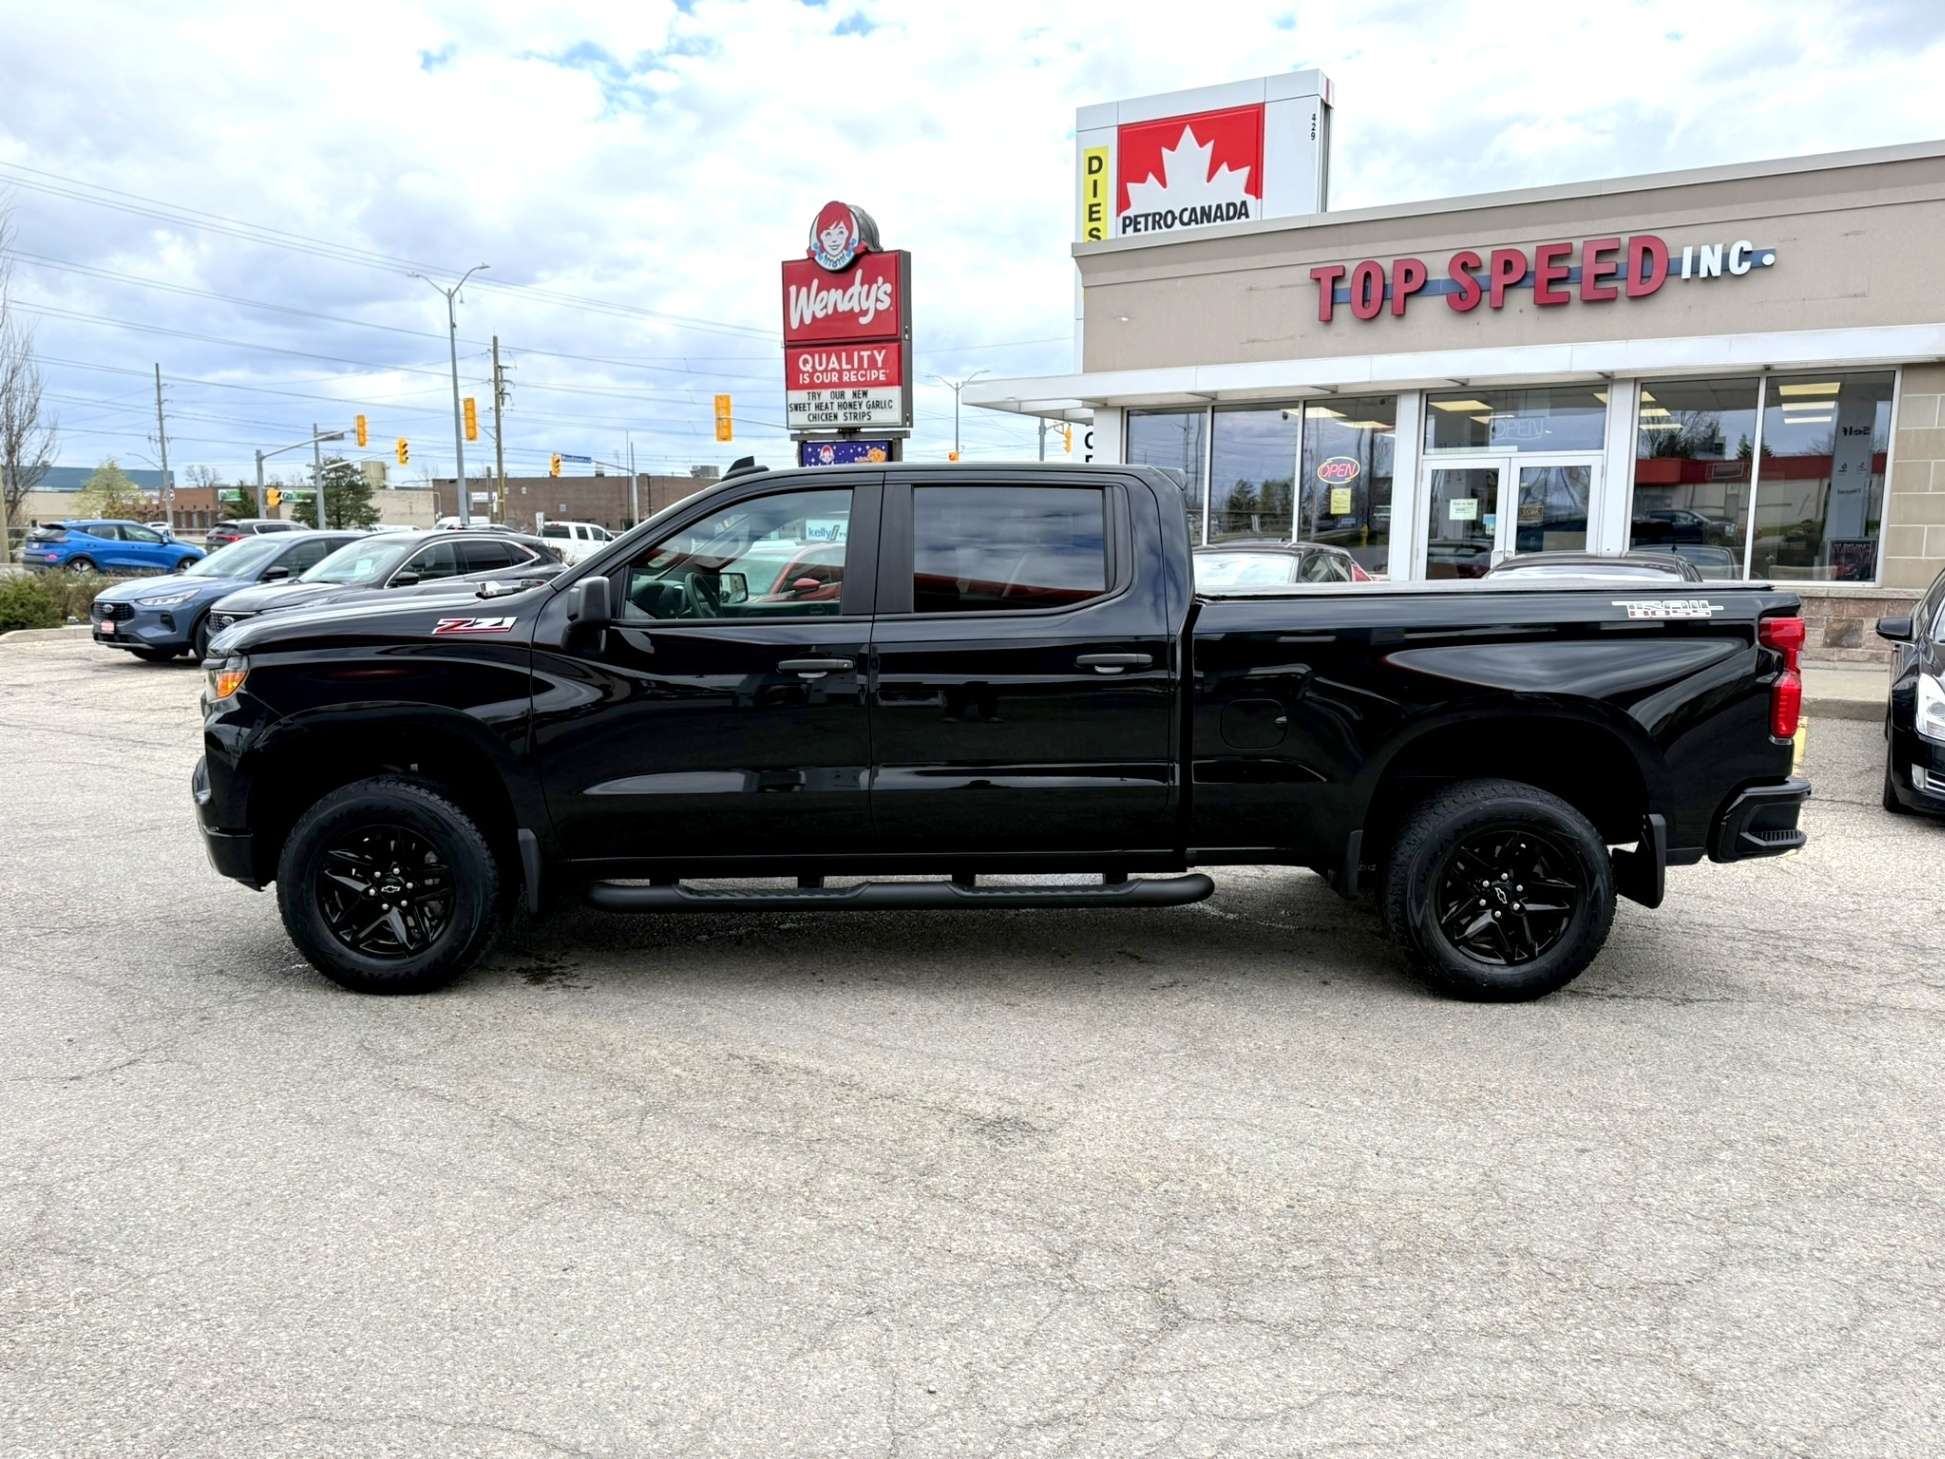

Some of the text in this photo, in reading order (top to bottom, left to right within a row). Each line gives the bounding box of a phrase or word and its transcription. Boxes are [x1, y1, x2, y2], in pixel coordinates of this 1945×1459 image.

[1310, 234, 1776, 322] TOP SPEED INC.
[788, 268, 893, 331] Wendy's
[798, 350, 887, 373] QUALITY
[799, 369, 887, 385] IS OUR RECIPE
[807, 389, 868, 401] TRY OUR NEW
[789, 399, 893, 412] SWEET HEAT HONEY GARLIC
[807, 411, 872, 422] CHICKEN STRIPS
[1320, 463, 1357, 478] OPEN
